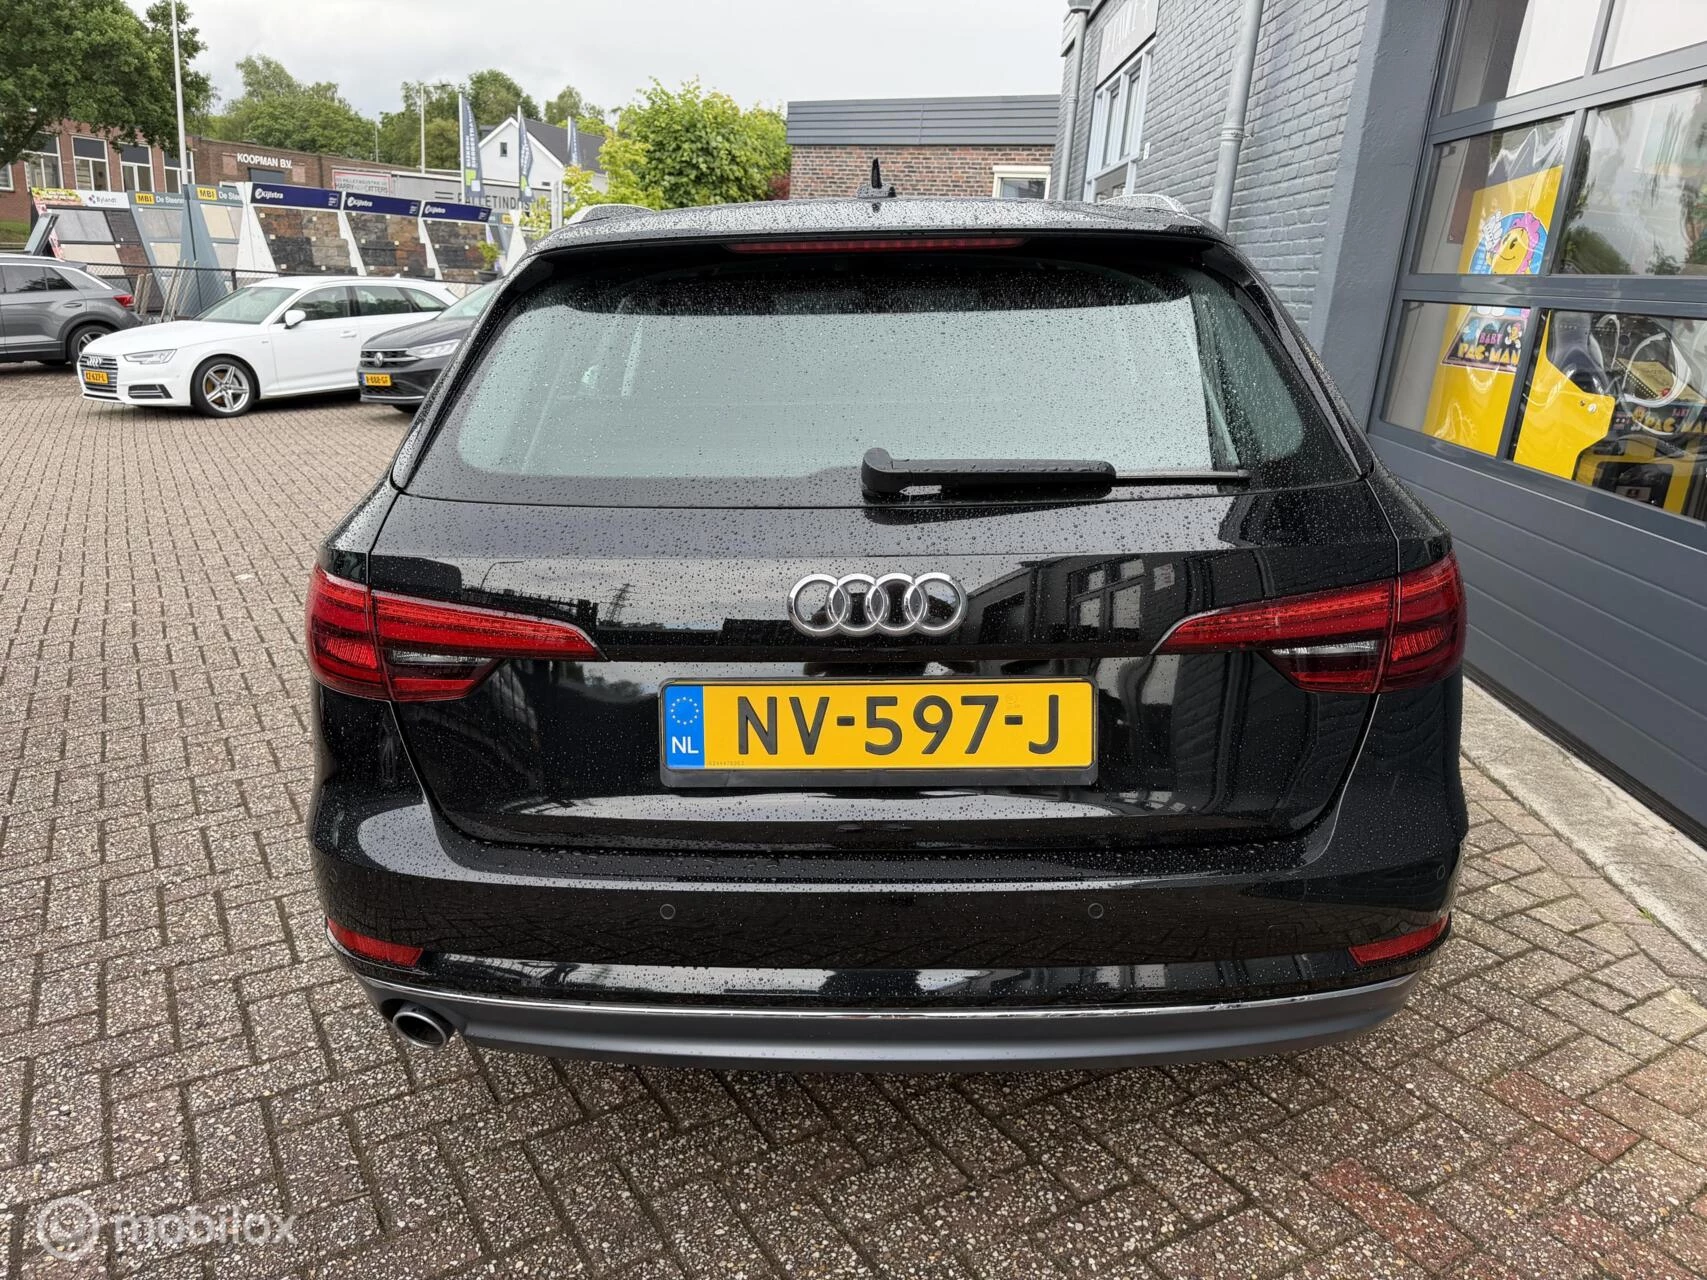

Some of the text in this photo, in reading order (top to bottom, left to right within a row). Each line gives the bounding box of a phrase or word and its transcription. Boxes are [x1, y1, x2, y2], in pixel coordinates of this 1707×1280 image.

[237, 152, 279, 167] KOOPMAN
[737, 694, 1059, 756] NV-597-J
[672, 736, 699, 754] NL
